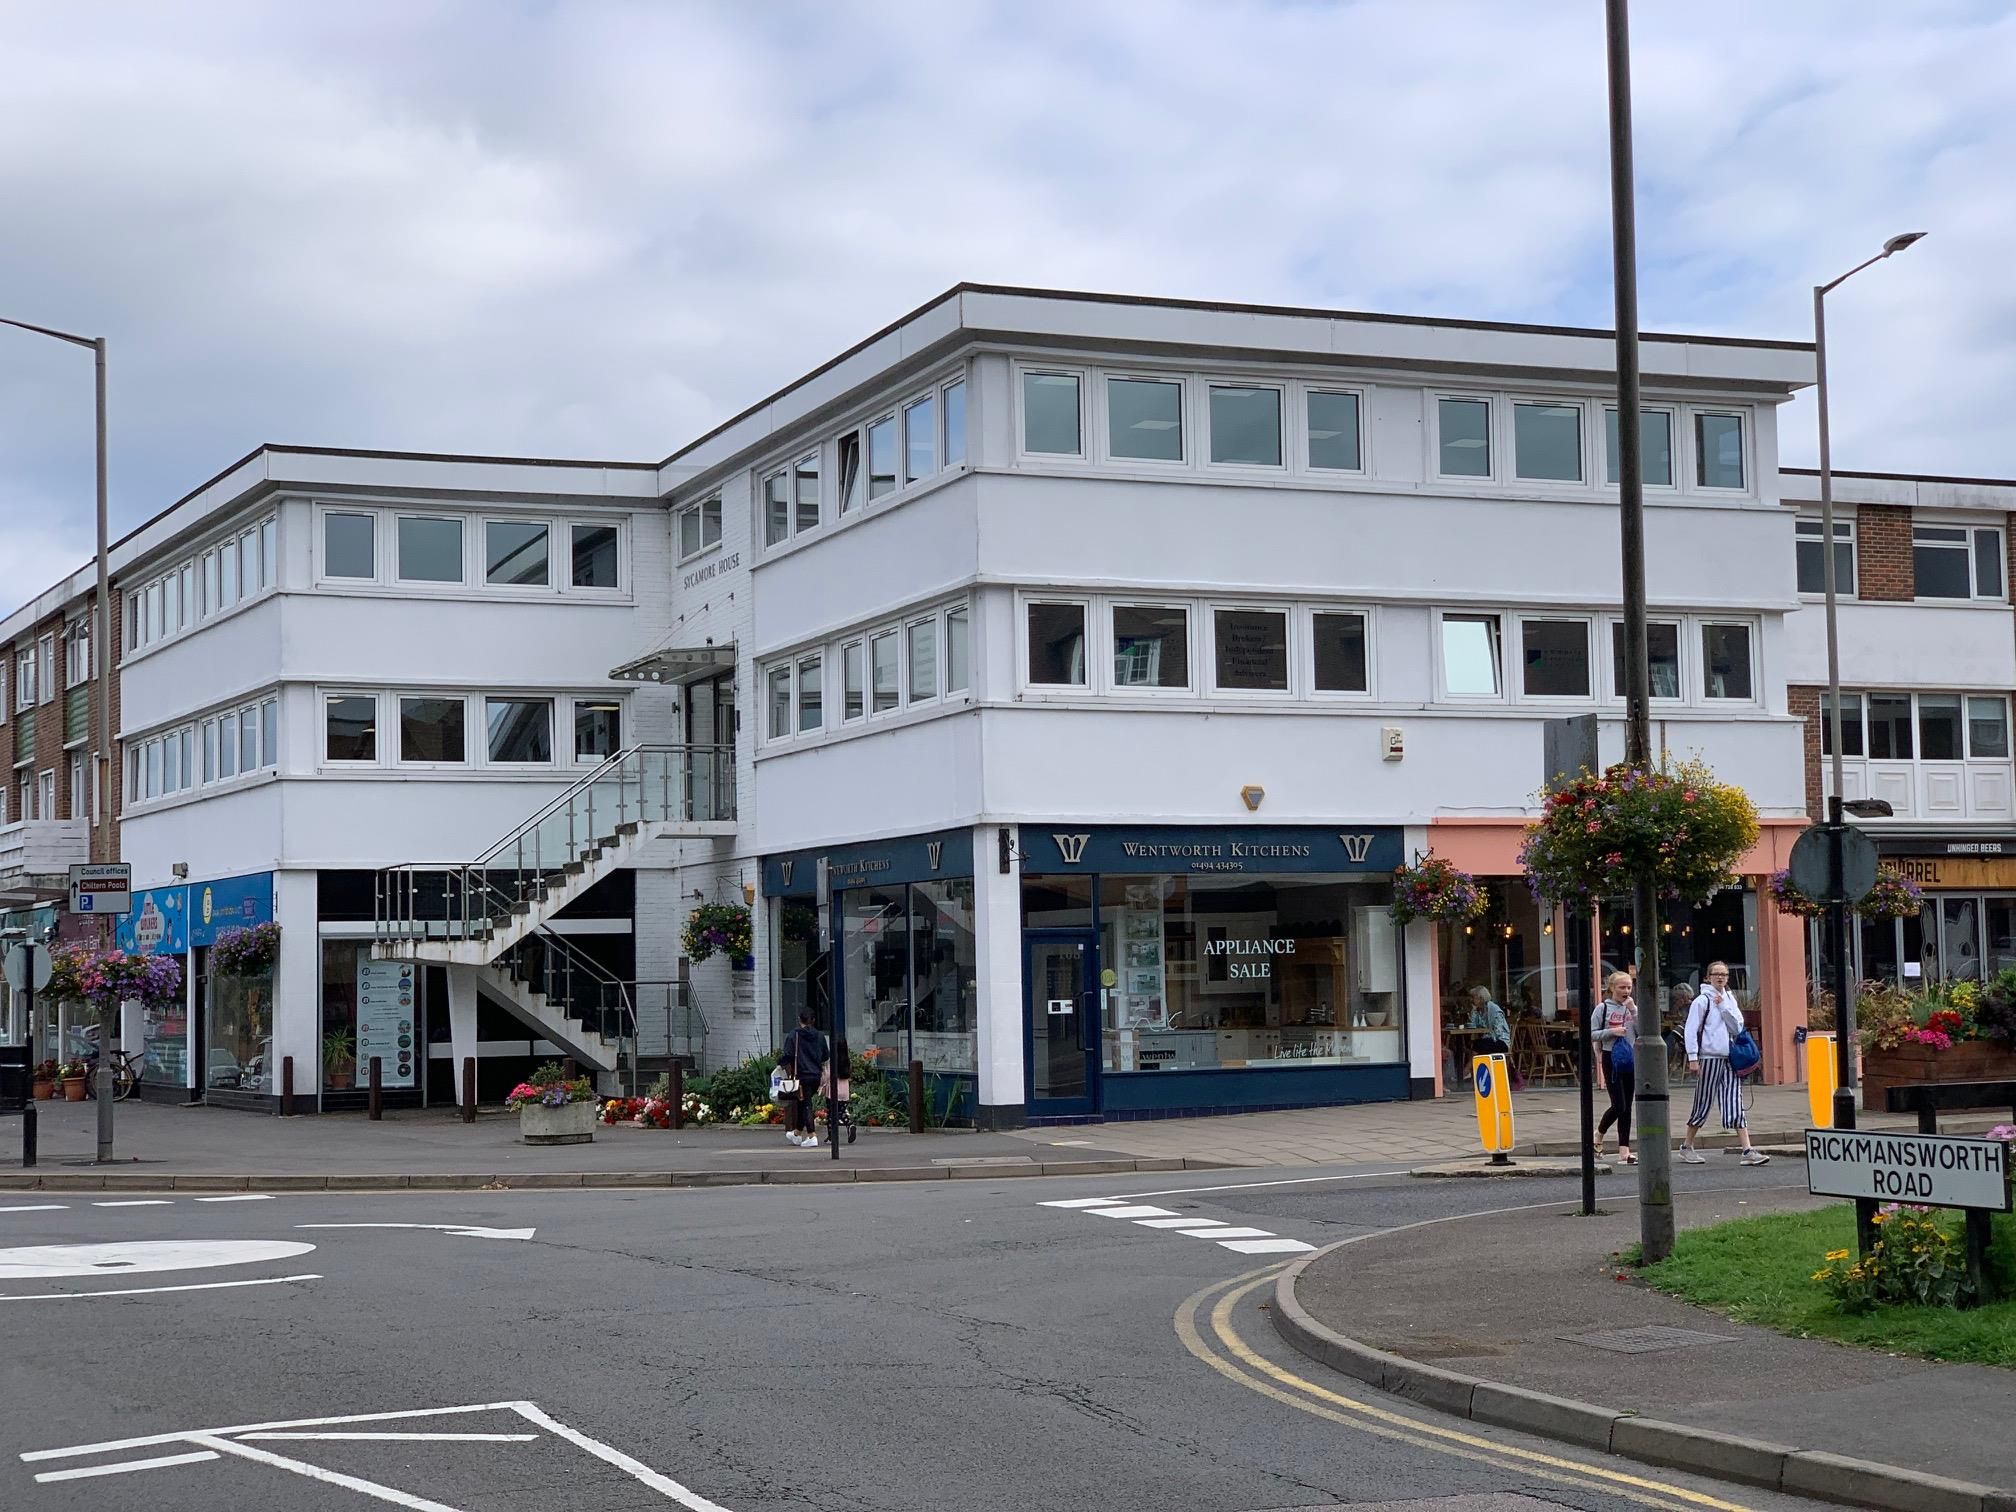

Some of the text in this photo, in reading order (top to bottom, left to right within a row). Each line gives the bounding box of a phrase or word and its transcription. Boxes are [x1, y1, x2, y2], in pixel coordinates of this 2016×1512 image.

[684, 552, 739, 590] SYCAMORE HOUSE
[1123, 842, 1310, 857] WENTWORTH KITCHENS
[1947, 843, 2002, 853] UNHINGED BEERS
[81, 867, 128, 876] Council offices
[1191, 861, 1243, 870] 01494 434305
[81, 881, 126, 890] Chiltern Pools
[1203, 939, 1295, 955] APPLIANCE
[1230, 963, 1271, 978] SALE
[1810, 1136, 2000, 1172] RICKMANSWORTH
[1873, 1170, 1933, 1197] ROAD
